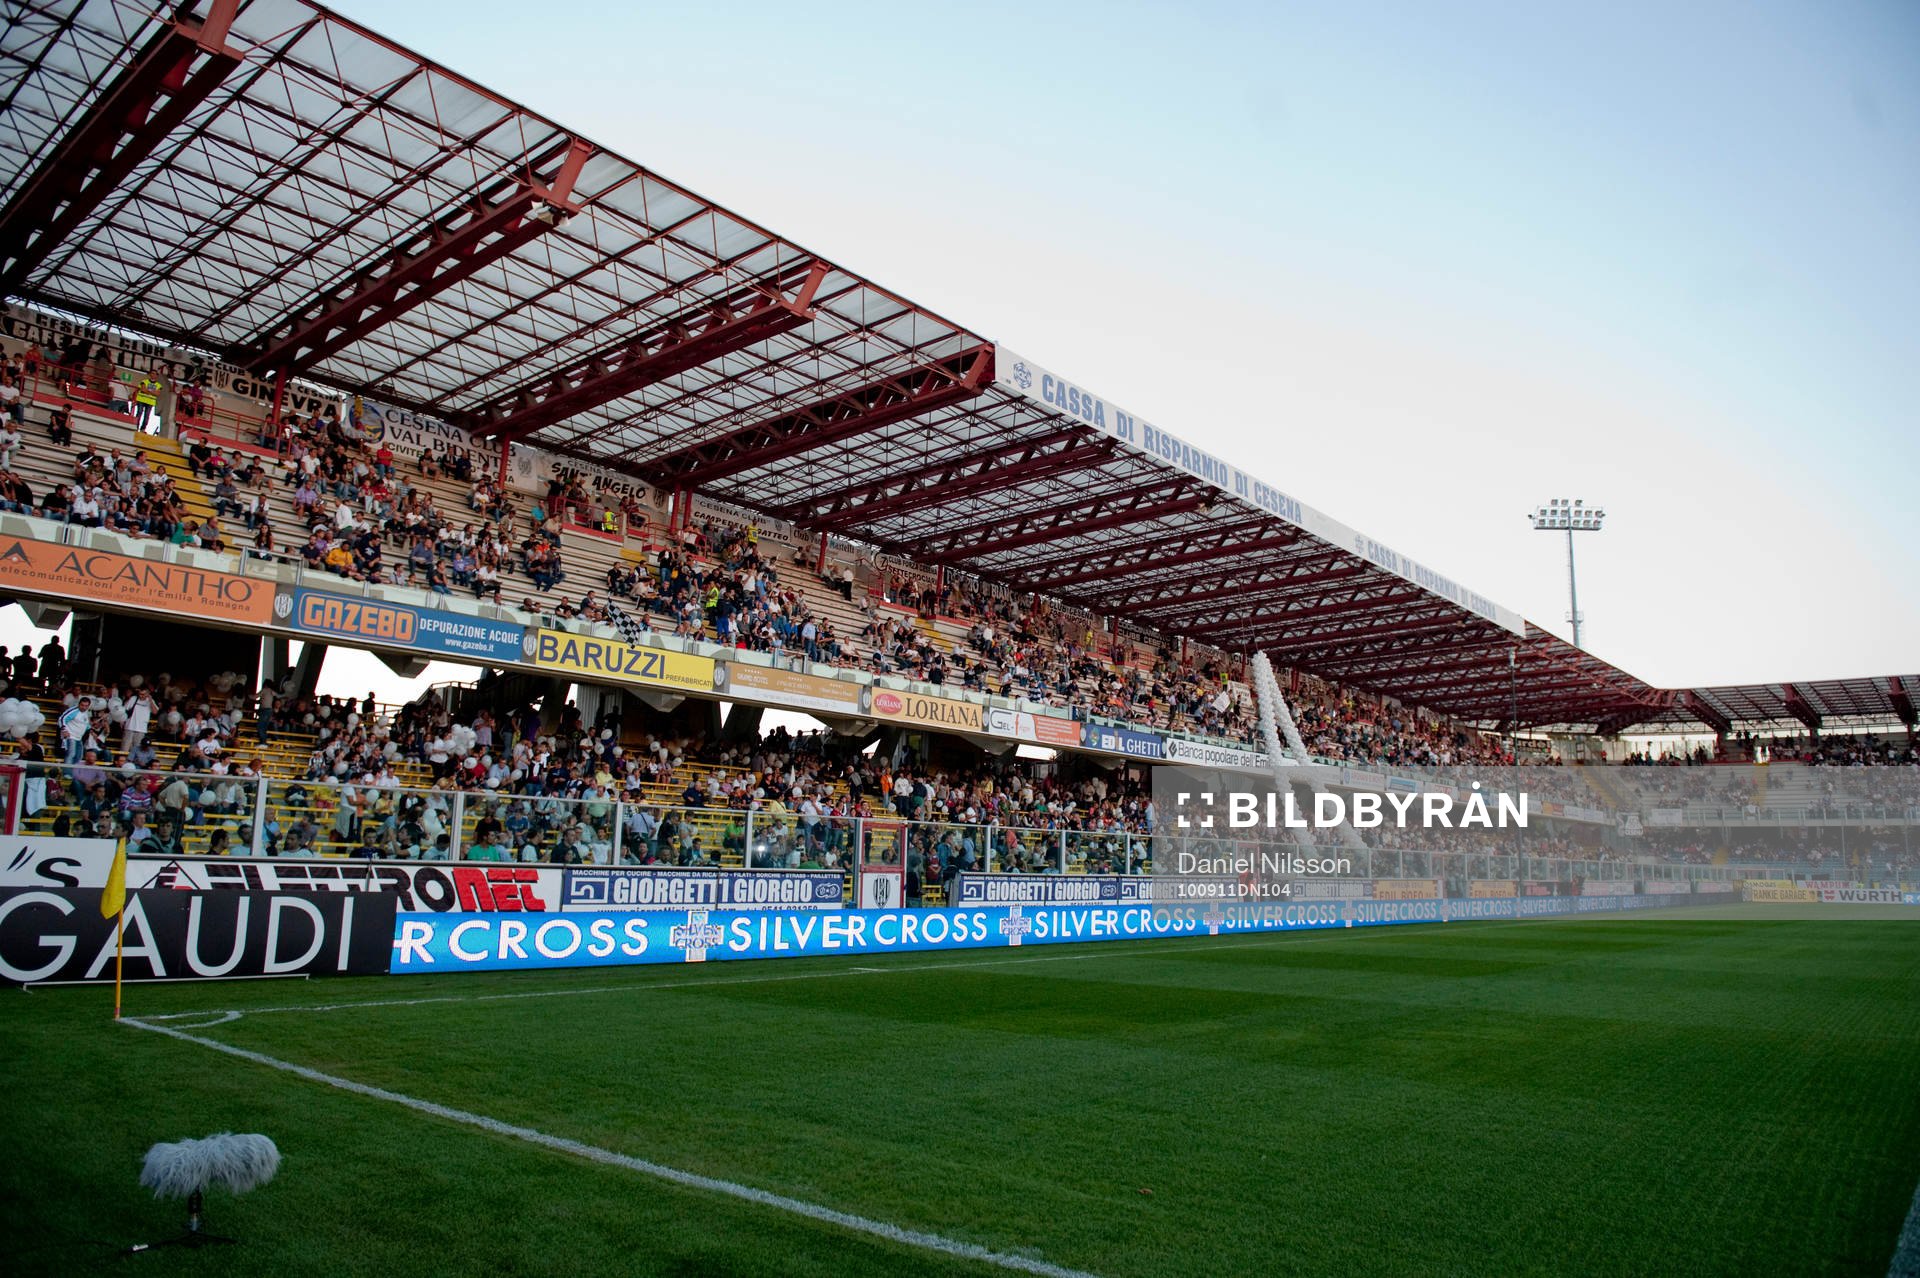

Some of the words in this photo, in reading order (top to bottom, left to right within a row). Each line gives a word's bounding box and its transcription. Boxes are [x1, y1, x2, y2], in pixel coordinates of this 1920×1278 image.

[215, 362, 246, 377] CLUB
[385, 409, 463, 443] CESENA
[389, 426, 427, 448] VAL
[1041, 374, 1107, 430] CASSA
[1115, 410, 1135, 442] DI
[1143, 423, 1229, 488] RISPARMIO
[1234, 471, 1249, 498] DI
[1254, 481, 1303, 525] CESENA
[1366, 539, 1399, 572] CASSA
[54, 550, 253, 603] ACANTHO
[121, 585, 141, 595] per
[201, 597, 251, 612] Romagna
[303, 595, 414, 642] GAZEBO
[419, 617, 487, 641] DEPURAZIONE
[488, 628, 520, 645] ACQUE
[444, 637, 494, 653] www.gazebo.it
[538, 633, 666, 680] BARUZZI
[664, 674, 713, 688] PREFABBRICATI
[904, 697, 980, 728] LORIANA
[1126, 738, 1161, 757] GHETTI
[1177, 741, 1204, 759] Banca
[1204, 750, 1239, 767] popolare
[572, 869, 608, 877] MACCHINE
[609, 870, 621, 878] PER
[622, 870, 650, 878] CUCIRE
[613, 877, 730, 904] GIORGETTI
[736, 877, 812, 904] GIORGIO
[986, 879, 1054, 902] GIORGETTI
[1054, 880, 1101, 902] GIORGIO
[1839, 890, 1903, 903] WÜRTH
[0, 891, 355, 982] GAUDI
